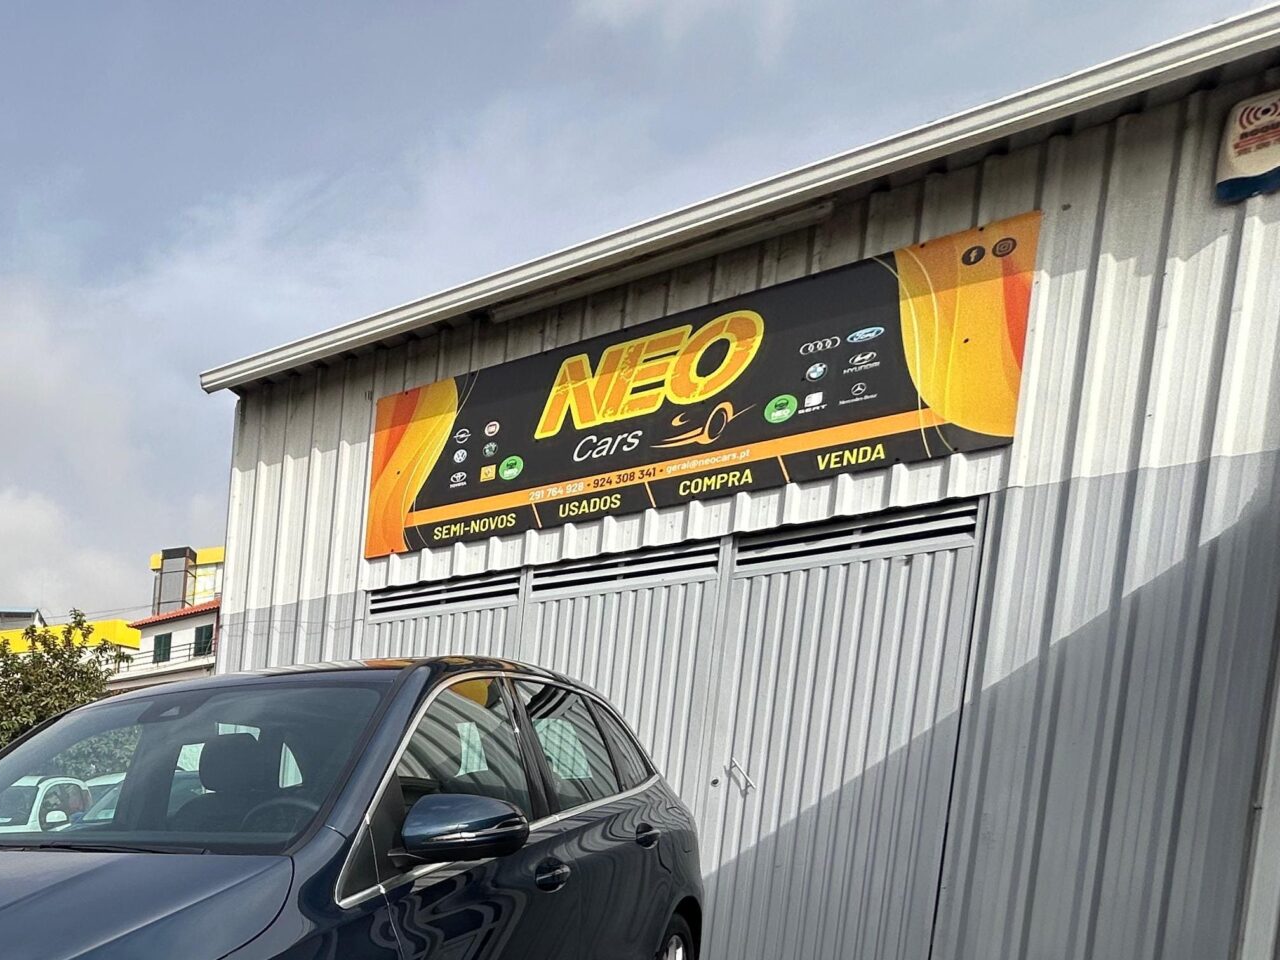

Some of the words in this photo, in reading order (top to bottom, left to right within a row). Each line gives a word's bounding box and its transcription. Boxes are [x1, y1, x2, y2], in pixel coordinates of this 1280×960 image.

[534, 310, 764, 439] NEO
[573, 430, 643, 462] Cars
[817, 443, 886, 470] VENDA
[528, 491, 544, 501] 291
[546, 486, 564, 498] 764
[565, 482, 584, 494] 928
[593, 476, 612, 488] 924
[615, 472, 635, 484] 308
[638, 467, 656, 479] 341
[666, 449, 750, 474] geral@neocars.pt
[679, 469, 753, 496] COMPRA
[558, 493, 621, 518] USADOS
[433, 513, 516, 540] SEMI-NOVOS
